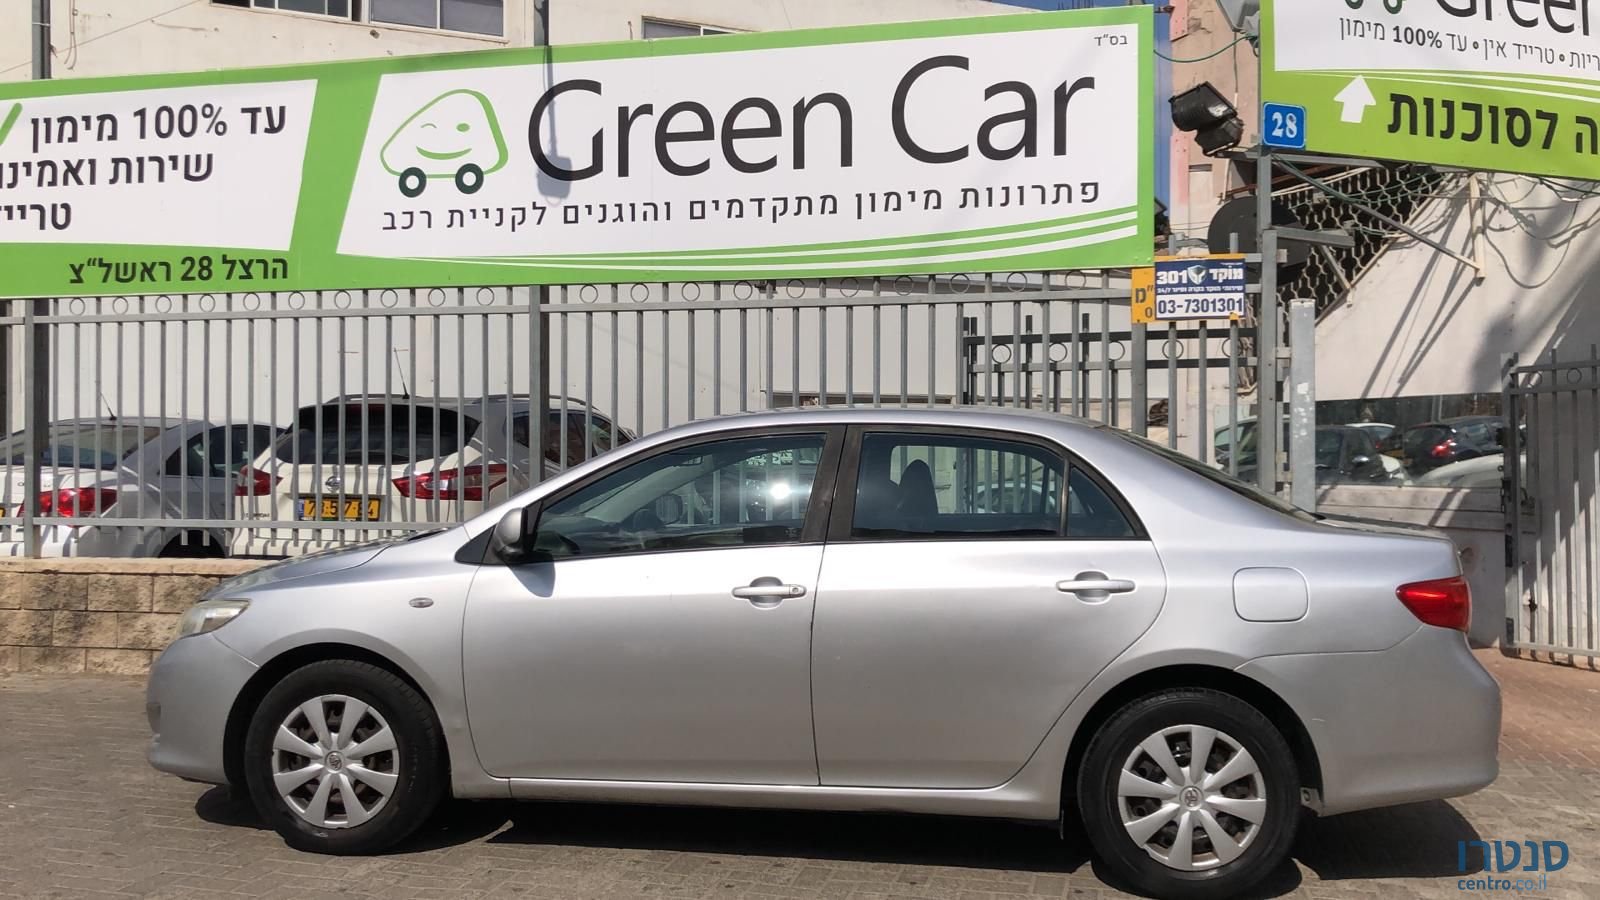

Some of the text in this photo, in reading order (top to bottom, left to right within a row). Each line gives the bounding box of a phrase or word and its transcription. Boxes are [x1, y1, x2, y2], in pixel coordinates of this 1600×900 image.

[1340, 18, 1384, 40] מימון
[1393, 26, 1442, 48] 100%
[1446, 33, 1466, 51] עד
[1484, 39, 1506, 60] אין
[31, 104, 285, 153] עד 100% מימון
[528, 55, 1094, 182] Green Car
[1272, 112, 1297, 138] 28
[1388, 93, 1558, 149] לסוכנות
[109, 154, 212, 184] שירות
[383, 182, 1098, 232] פתרונות מימון מתקדמים והוגנים לקניית רכב
[181, 256, 212, 281] 28
[222, 254, 289, 280] הרצל
[1156, 270, 1187, 285] 301
[1157, 298, 1243, 314] 03-7301301
